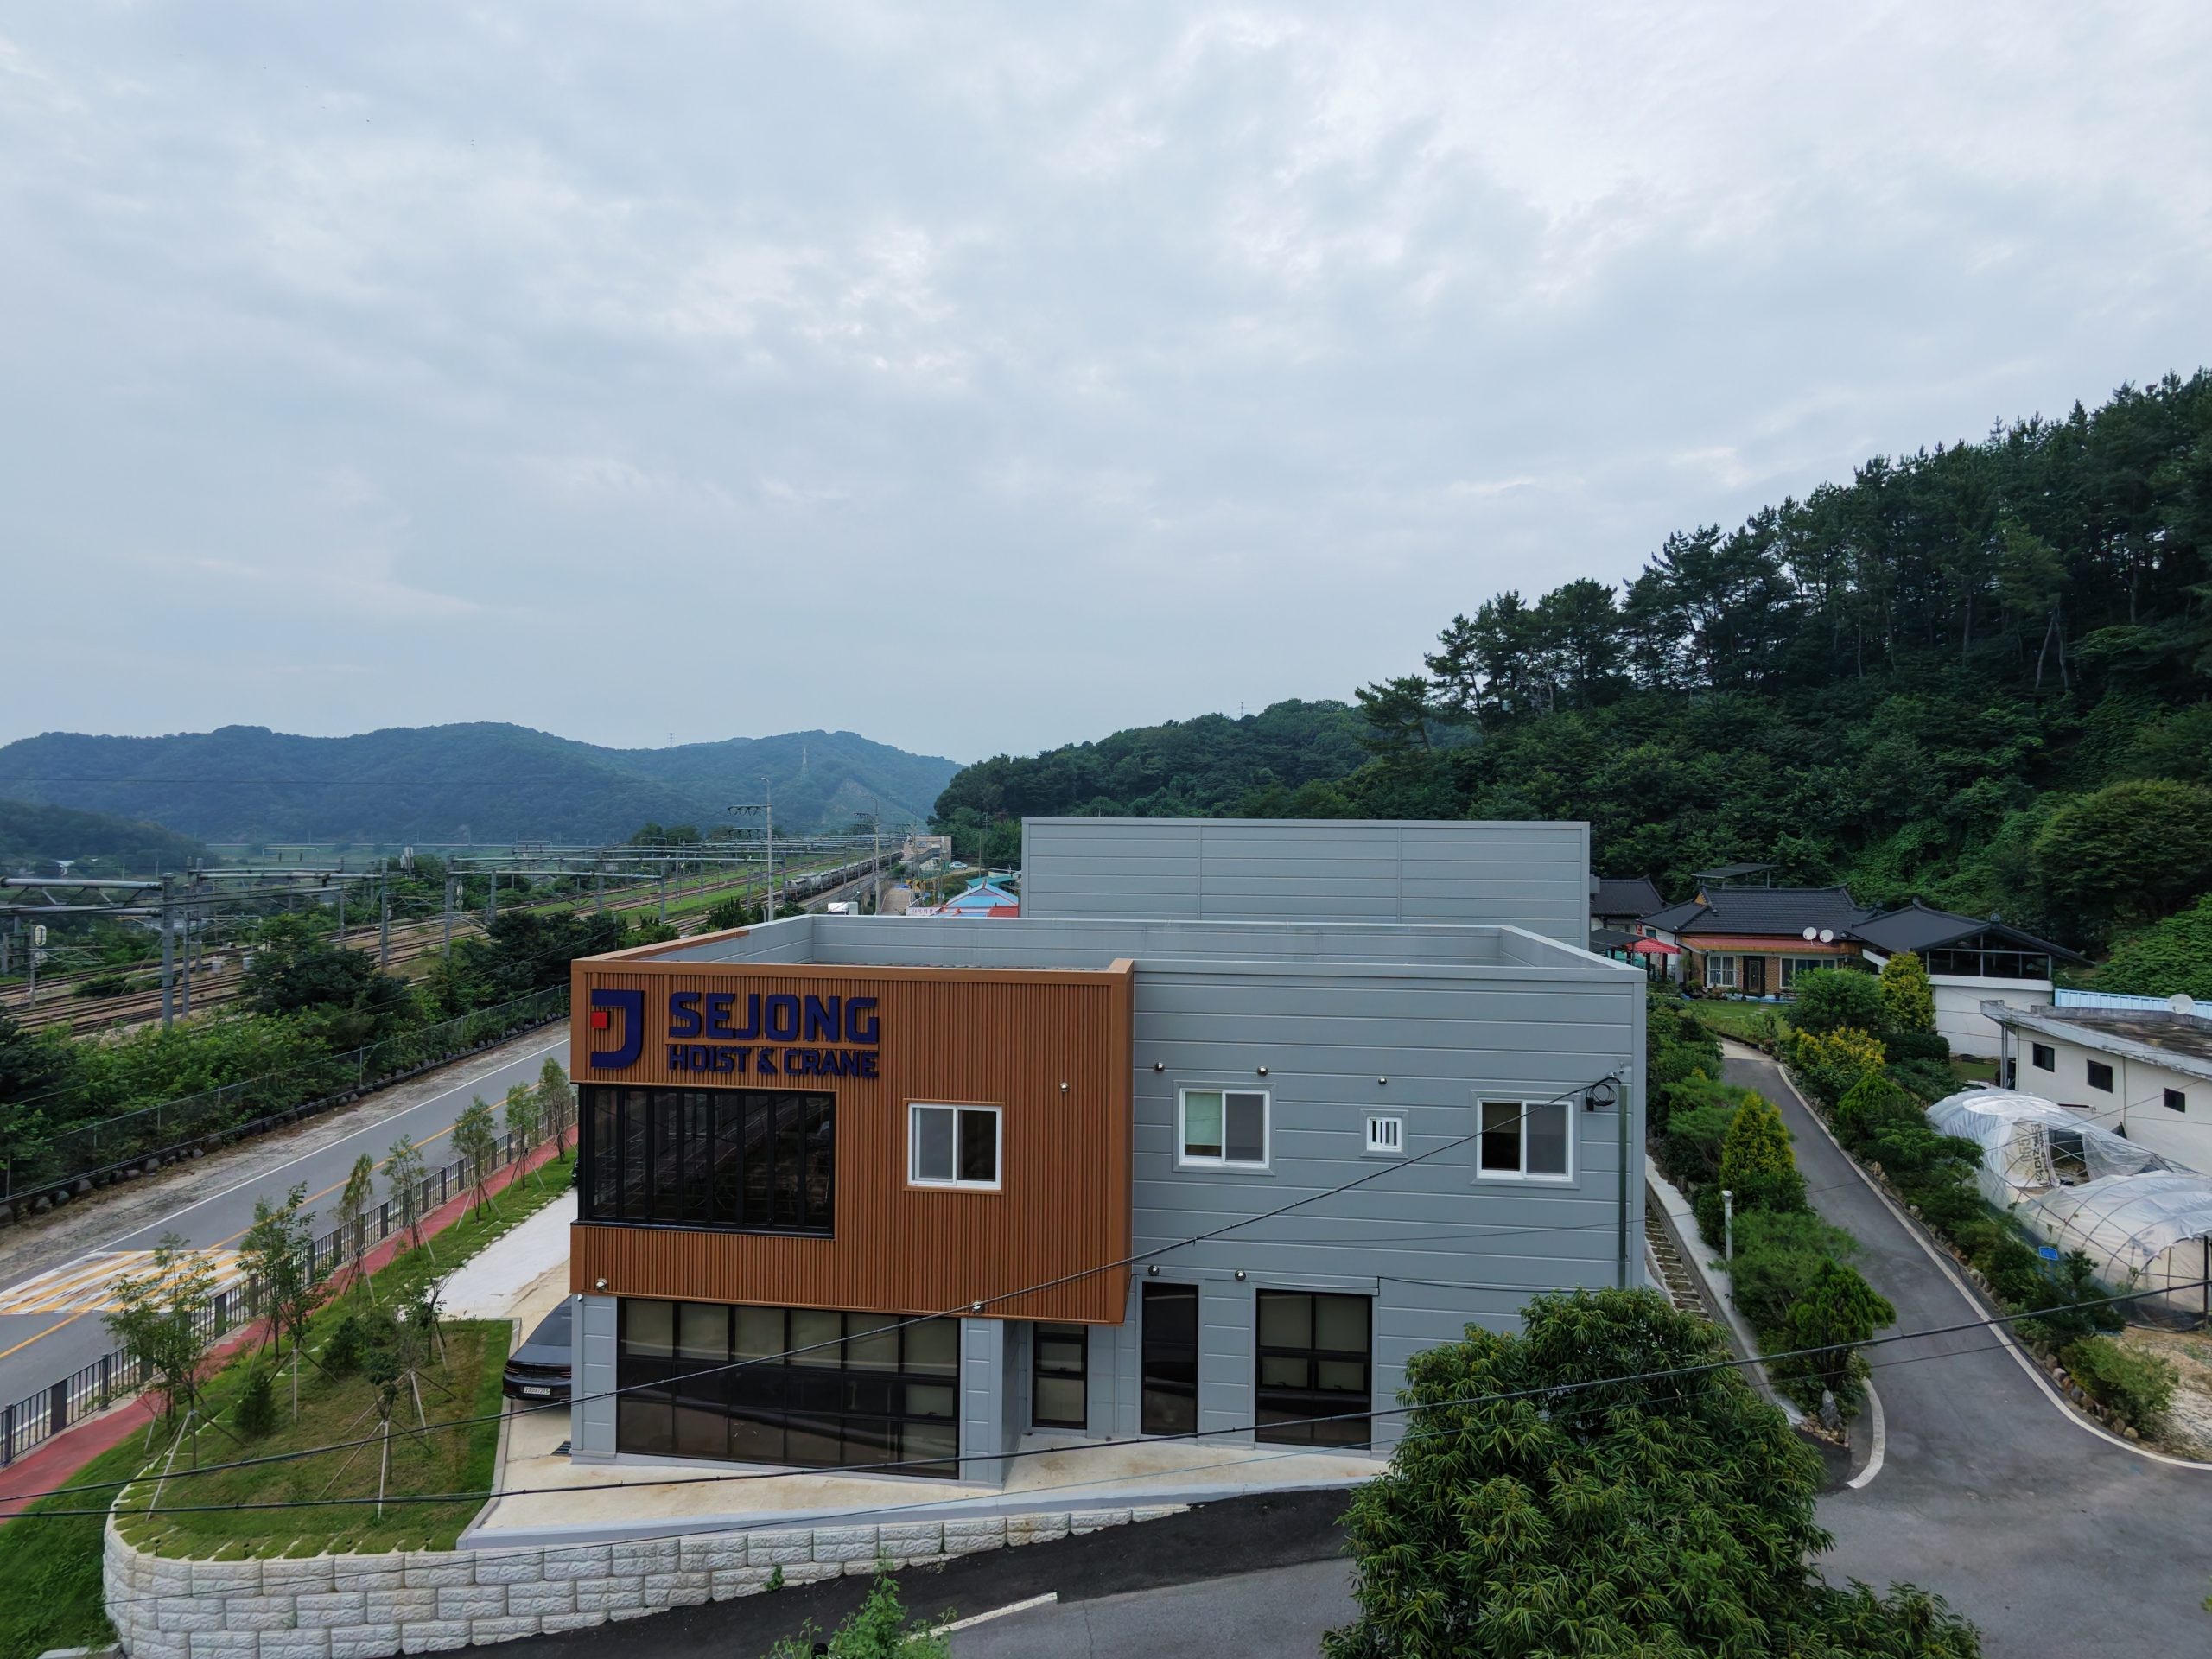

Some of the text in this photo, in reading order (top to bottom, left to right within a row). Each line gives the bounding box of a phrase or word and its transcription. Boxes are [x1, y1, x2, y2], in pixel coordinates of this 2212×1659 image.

[669, 992, 879, 1044] SEJONG
[669, 1045, 879, 1078] HOIST & CRANE
